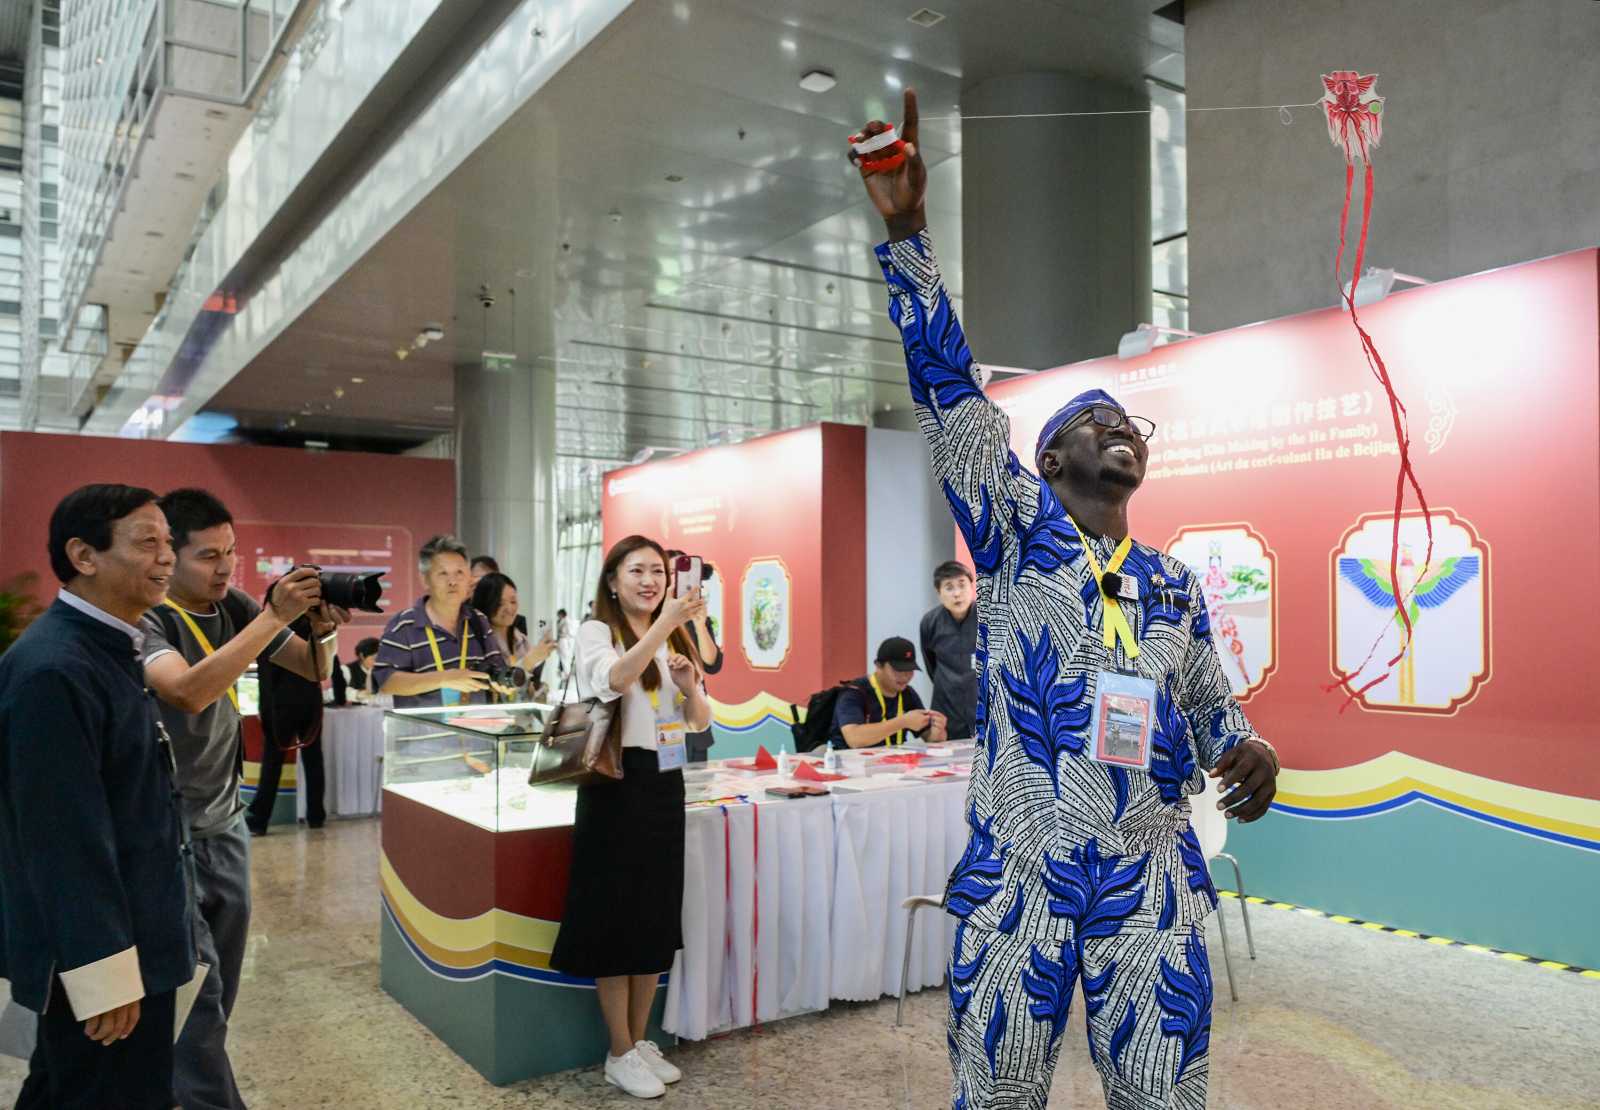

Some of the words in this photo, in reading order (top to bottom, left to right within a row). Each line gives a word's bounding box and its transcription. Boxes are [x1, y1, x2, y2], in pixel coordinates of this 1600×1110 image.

[1329, 422, 1378, 440] Family)
[1315, 448, 1333, 461] Ha
[1335, 445, 1351, 459] de
